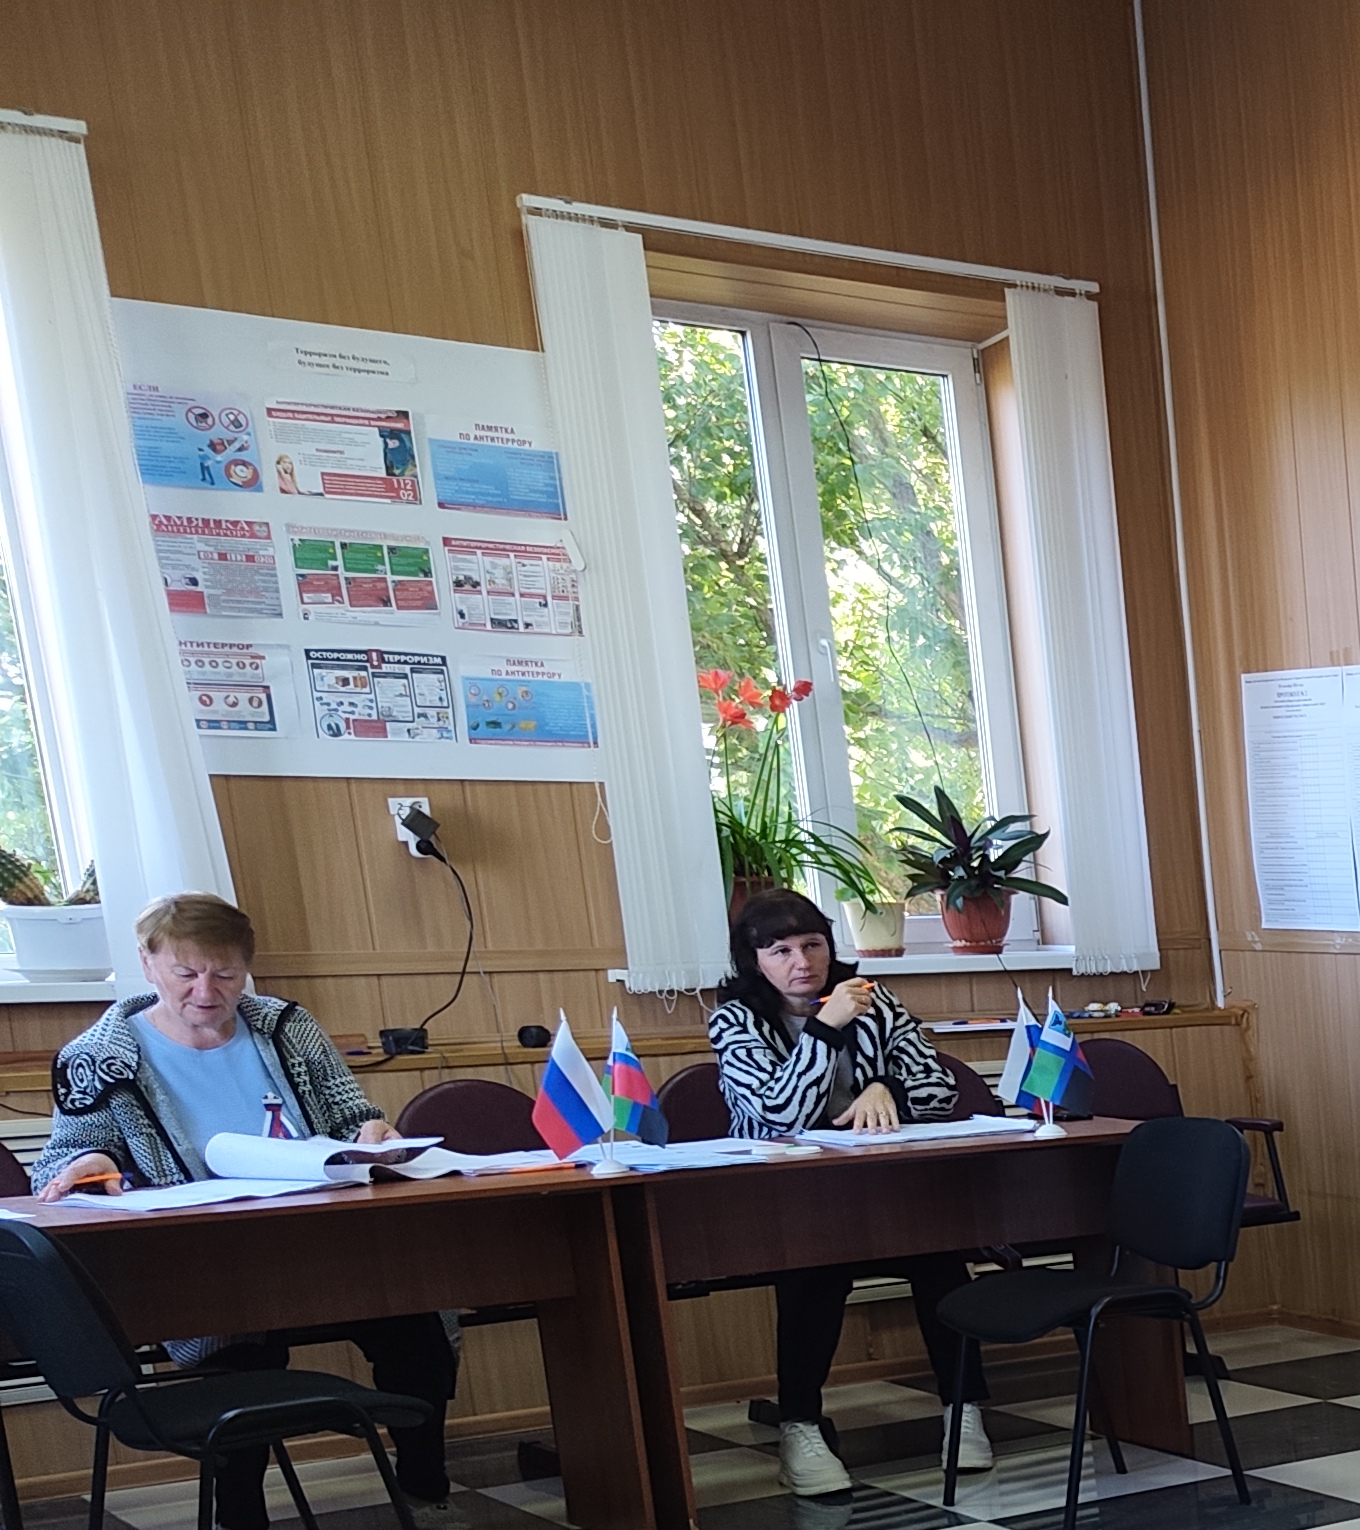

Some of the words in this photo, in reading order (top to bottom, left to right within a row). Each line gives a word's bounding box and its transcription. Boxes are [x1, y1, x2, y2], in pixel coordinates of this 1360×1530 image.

[295, 347, 337, 360] Терроризм
[338, 352, 351, 361] без
[132, 383, 160, 393] ЕСЛИ
[474, 423, 516, 435] ПАМЯТКА
[459, 432, 471, 441] ПО
[473, 434, 533, 448] АНТИТЕРРОРУ
[392, 478, 413, 490] 112
[400, 490, 415, 501] 02
[179, 640, 253, 651] НТИТЕРРОР
[309, 651, 368, 661] ОСТОРОЖНО
[383, 654, 443, 665] ТЕРРОРИЗМ
[506, 659, 545, 668] ПАМЯТКА
[491, 669, 502, 677] ПО
[505, 670, 562, 679] АНТИТЕРРОРУ
